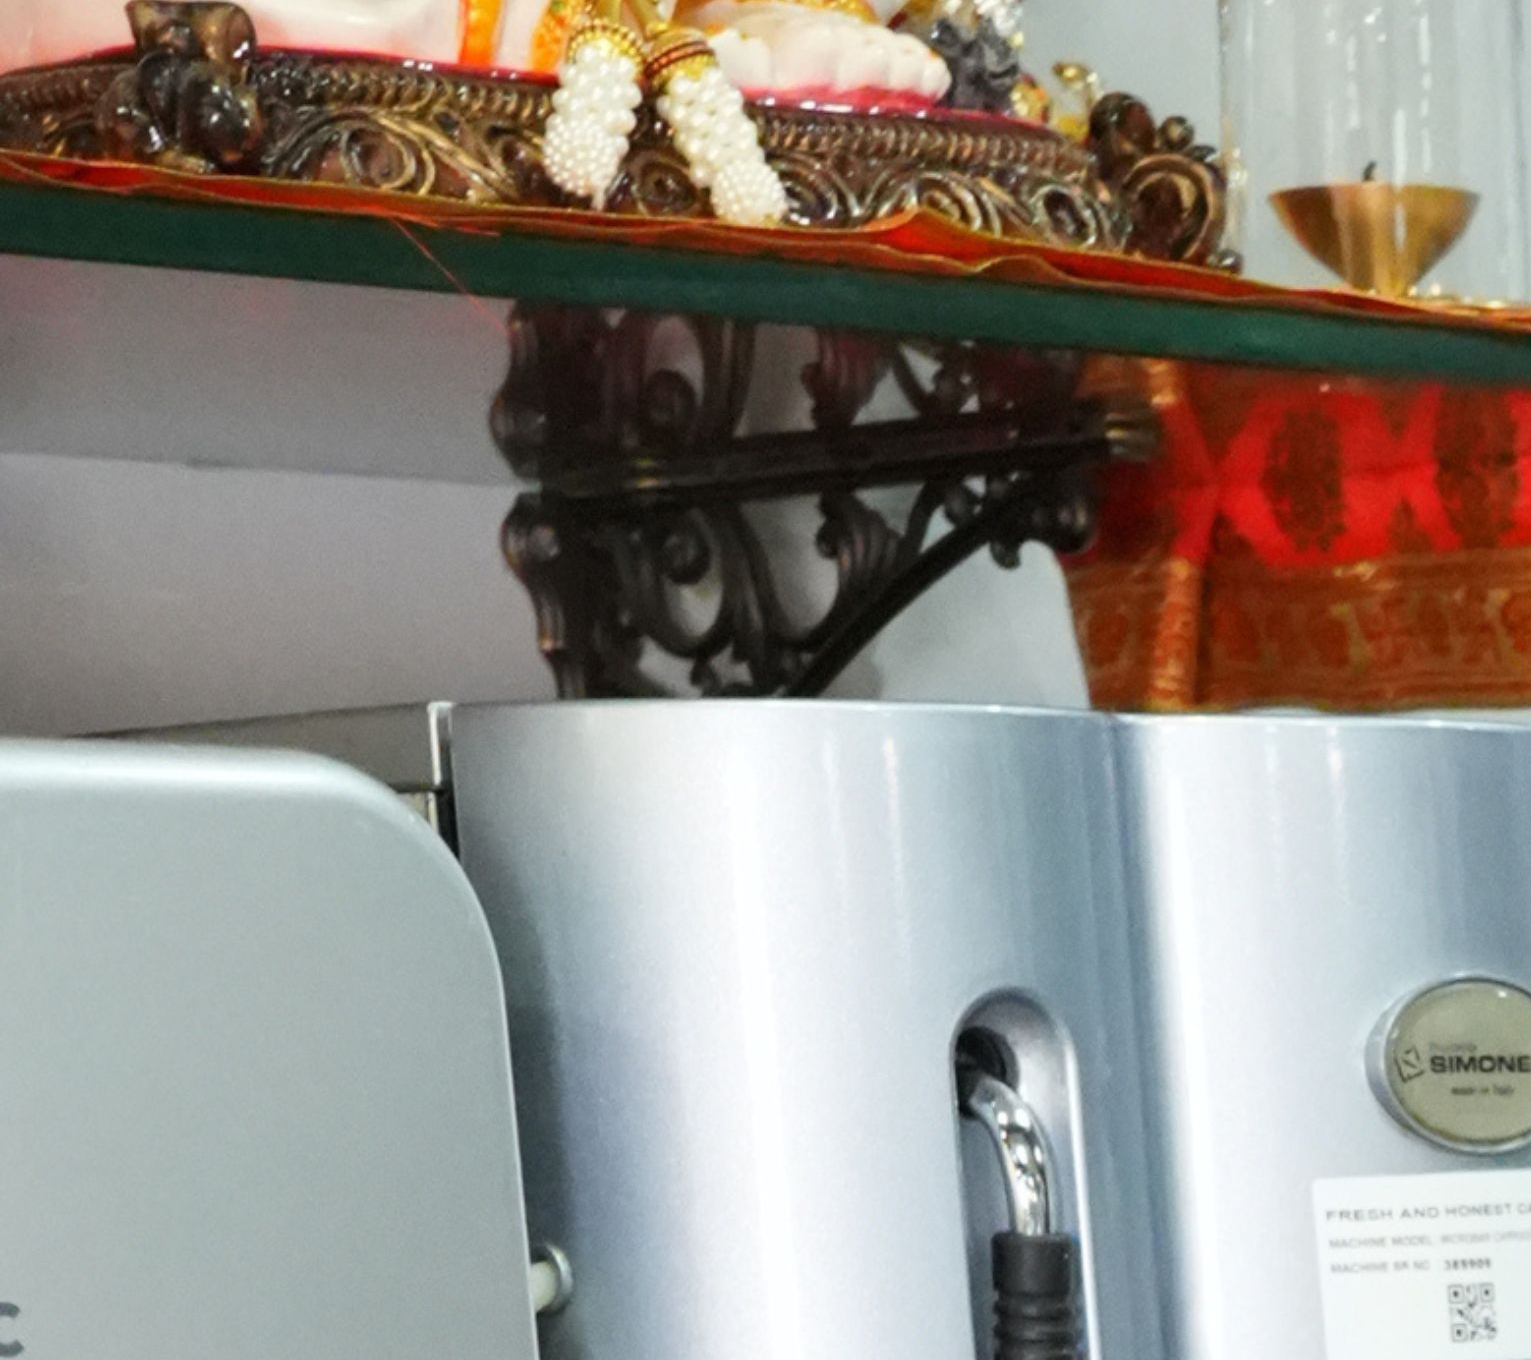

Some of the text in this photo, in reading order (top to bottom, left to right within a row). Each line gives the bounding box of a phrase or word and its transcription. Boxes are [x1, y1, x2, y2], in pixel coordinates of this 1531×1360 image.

[1325, 1209, 1394, 1222] FRESH
[1399, 1207, 1440, 1220] AND
[1444, 1202, 1513, 1217] HONEST
